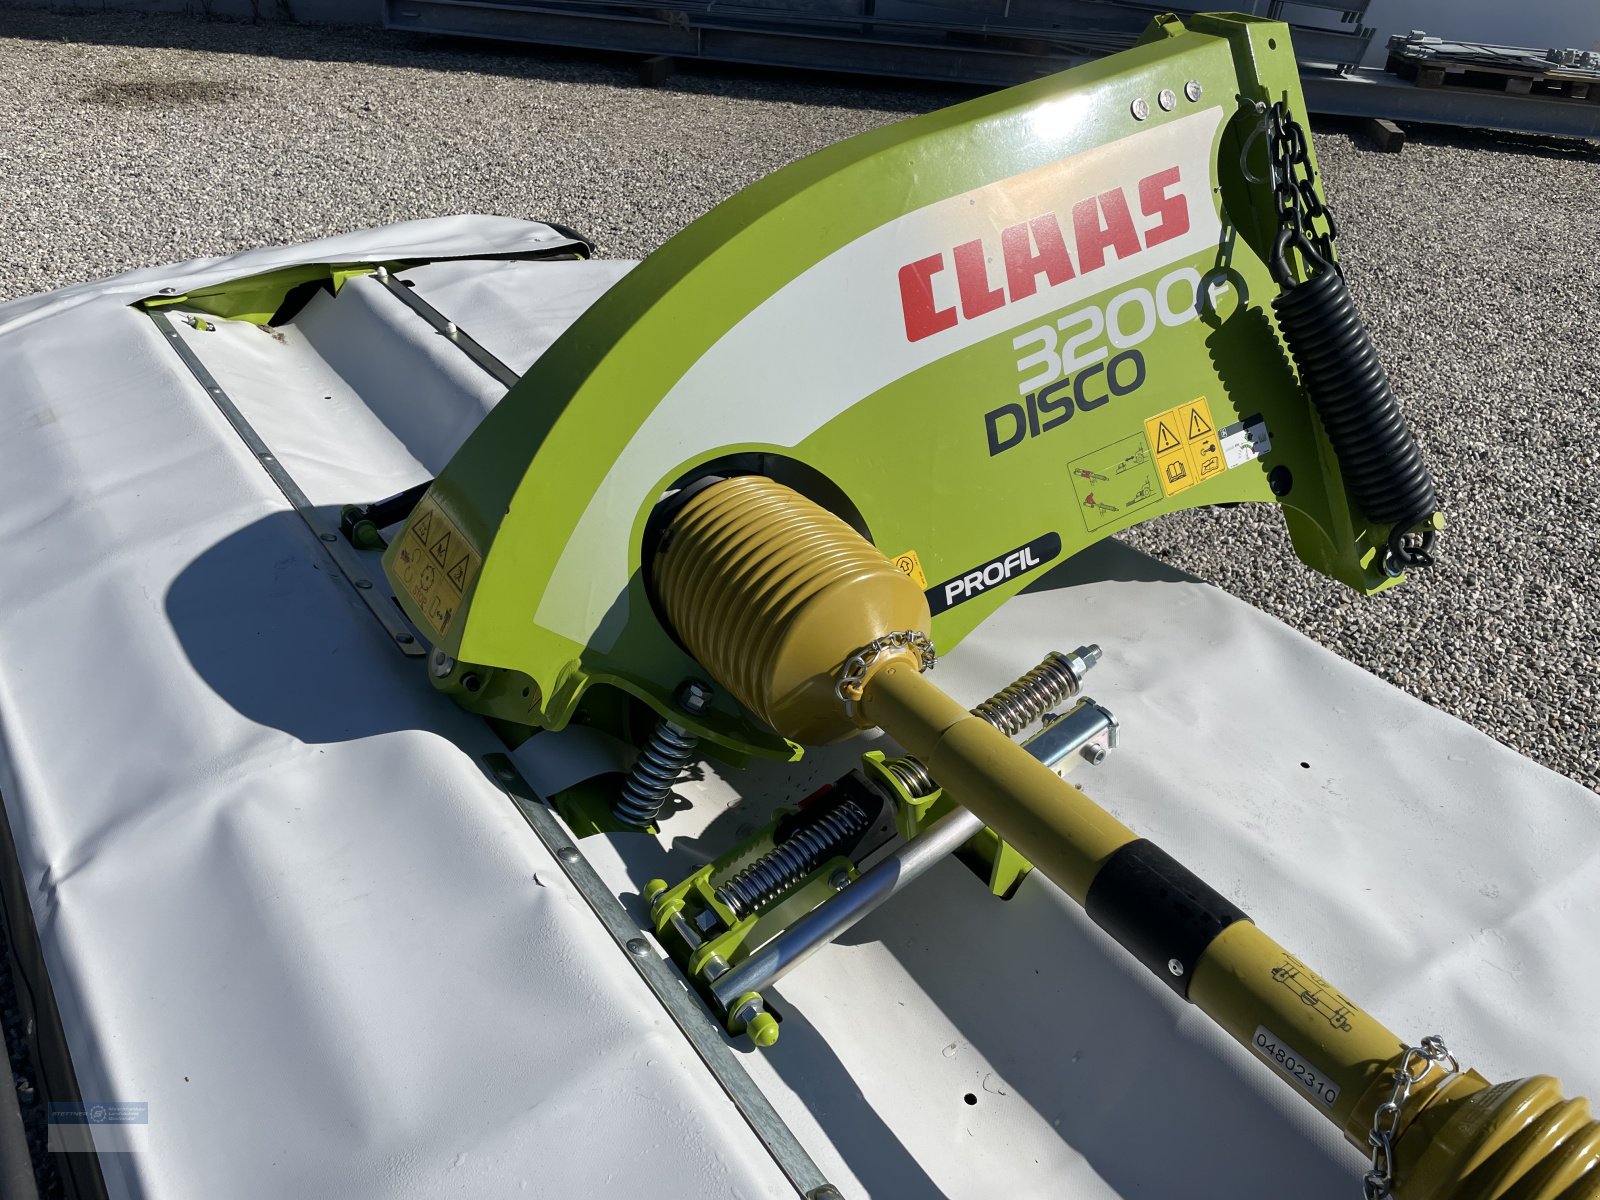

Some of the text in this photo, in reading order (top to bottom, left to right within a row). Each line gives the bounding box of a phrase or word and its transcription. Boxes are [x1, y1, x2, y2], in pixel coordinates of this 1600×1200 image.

[898, 165, 1190, 343] CLAAS
[984, 349, 1146, 457] DISCO
[944, 546, 1041, 606] PROFIL
[1256, 1034, 1336, 1104] 04802310
